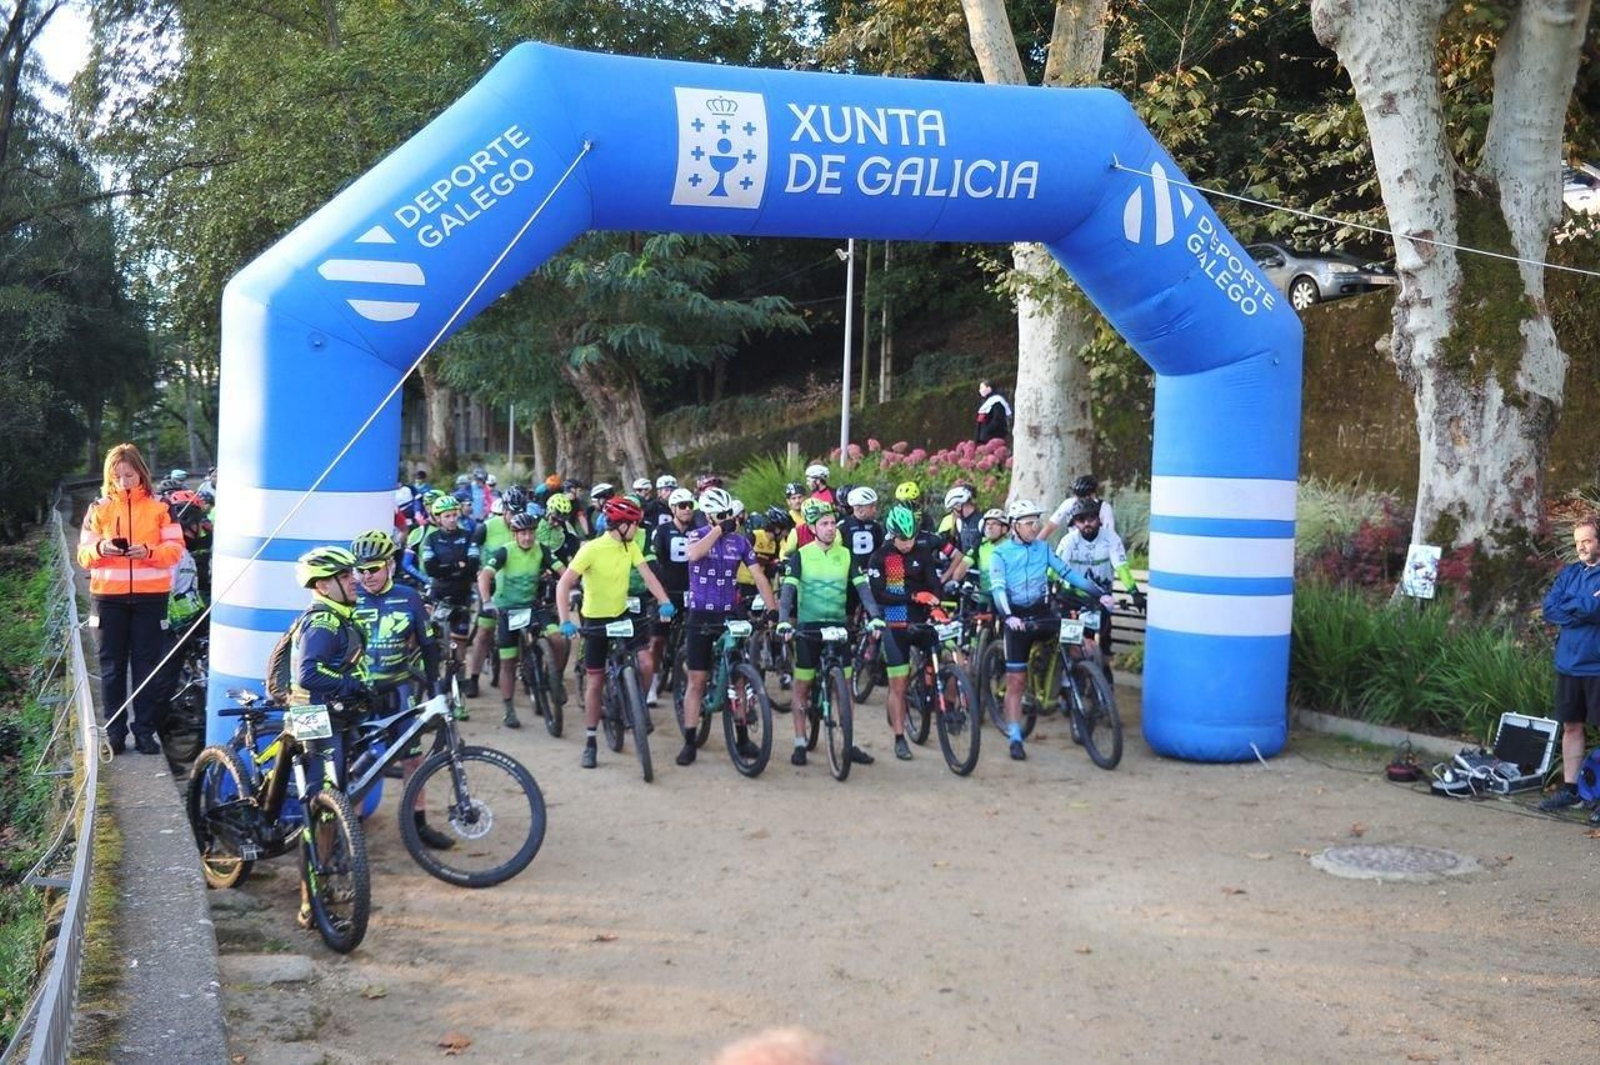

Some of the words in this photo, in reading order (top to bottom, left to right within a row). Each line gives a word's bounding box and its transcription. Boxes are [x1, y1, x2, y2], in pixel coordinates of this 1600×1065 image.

[787, 103, 946, 147] XUNTA
[394, 125, 531, 229] DEPORTE
[417, 158, 534, 248] GALEGO
[784, 152, 846, 195] DE
[857, 156, 1039, 200] GALICIA
[1186, 233, 1257, 315] GALEGO
[1197, 215, 1276, 311] DEPORTE
